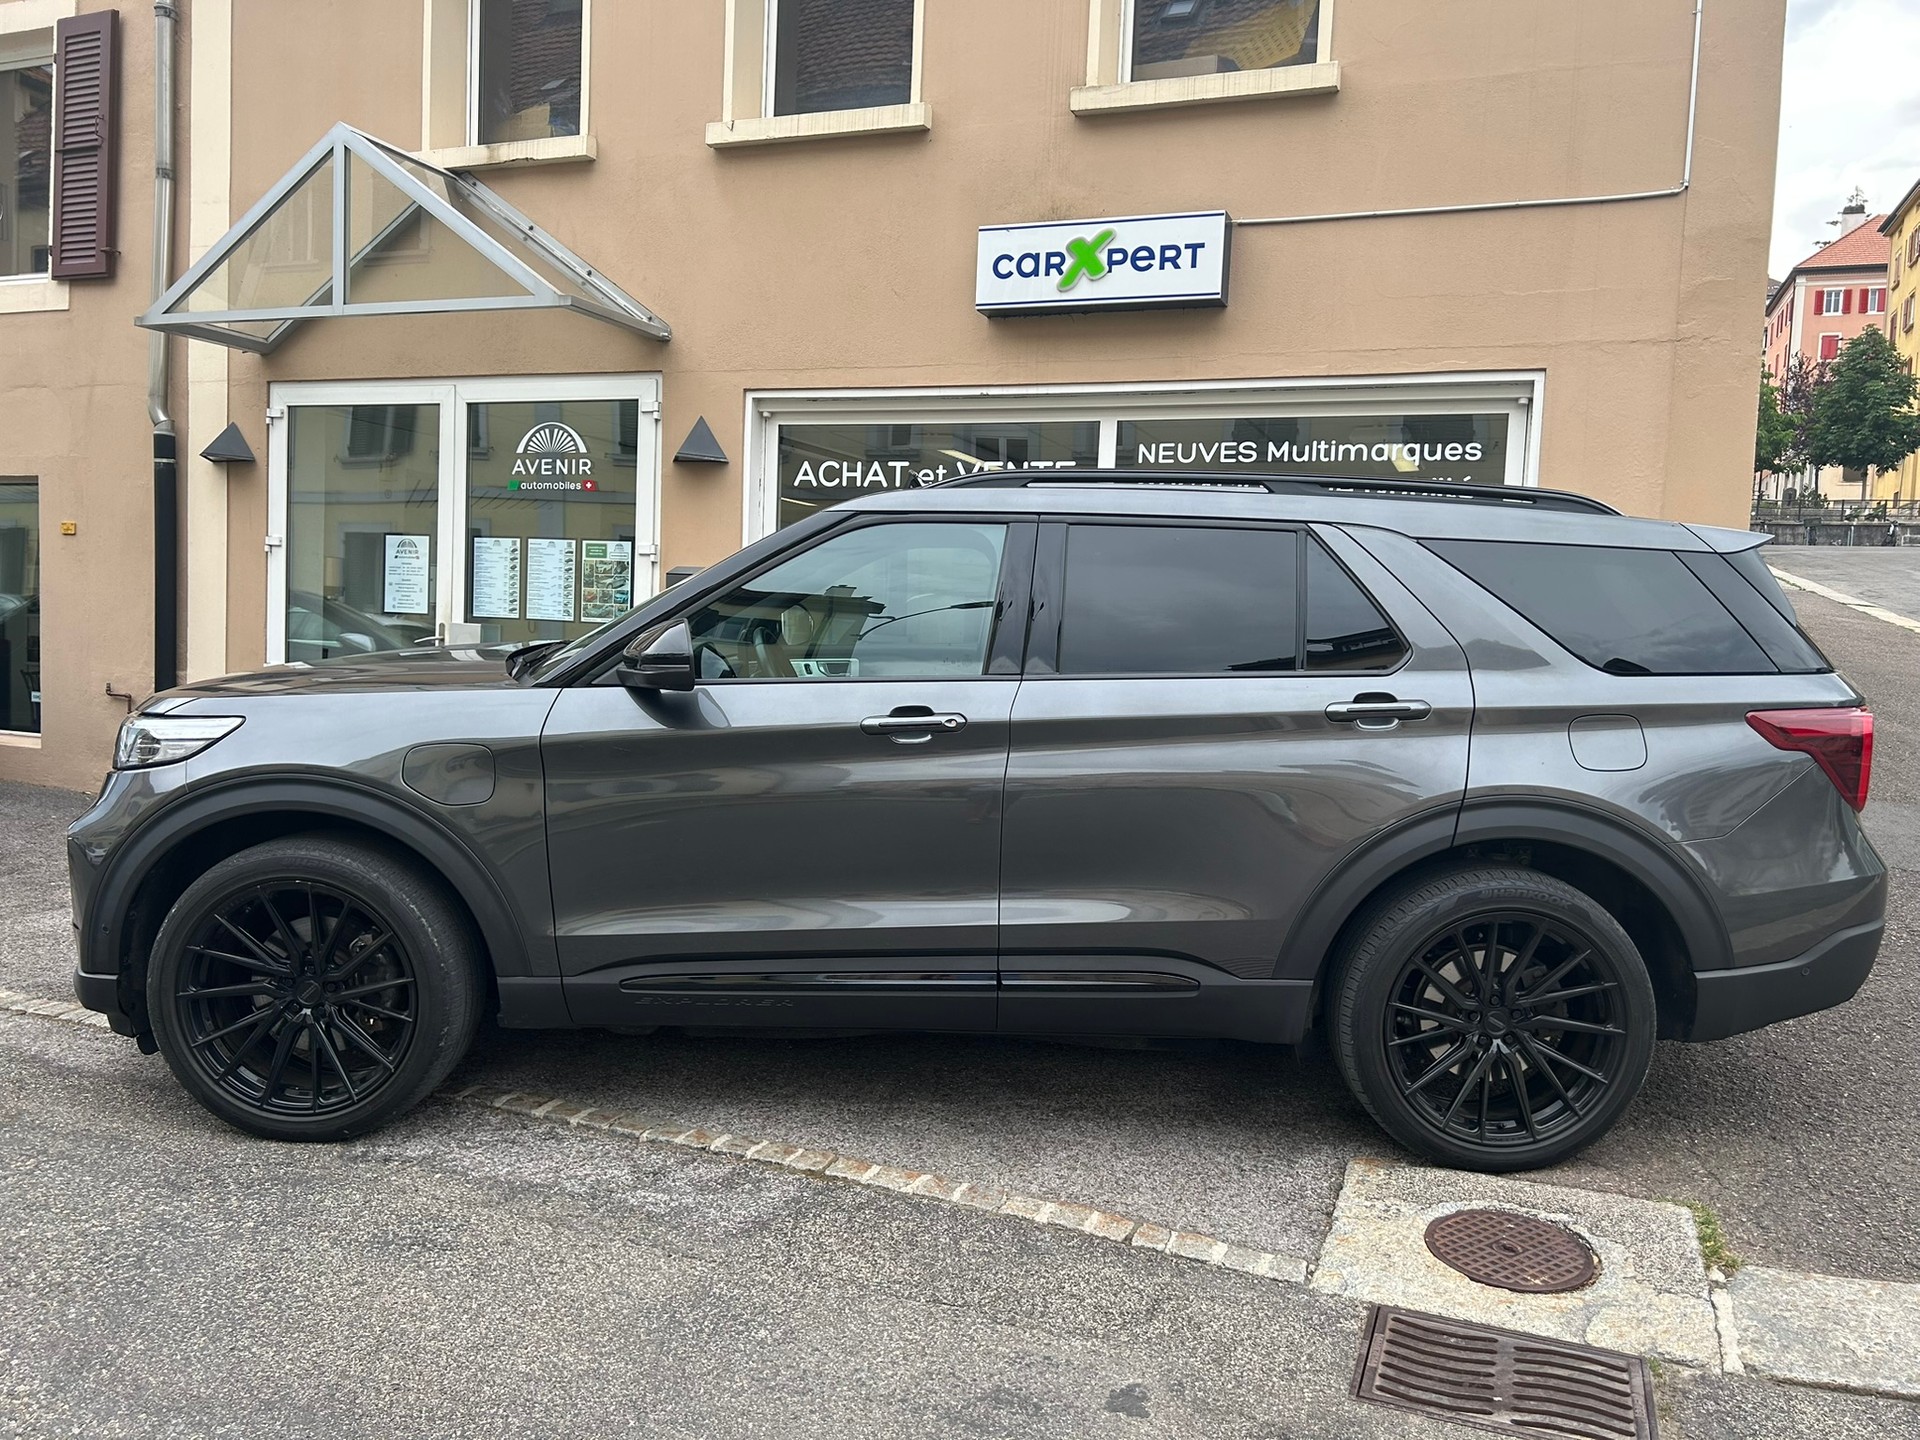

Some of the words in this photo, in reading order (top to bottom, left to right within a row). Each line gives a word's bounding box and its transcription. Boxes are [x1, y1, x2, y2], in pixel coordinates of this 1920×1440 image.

[1138, 442, 1258, 464] NEUVES
[1267, 440, 1483, 469] Multimarques
[512, 459, 592, 475] AVENIR
[793, 460, 910, 488] ACHAT
[918, 464, 948, 487] et
[520, 481, 582, 490] automobiles
